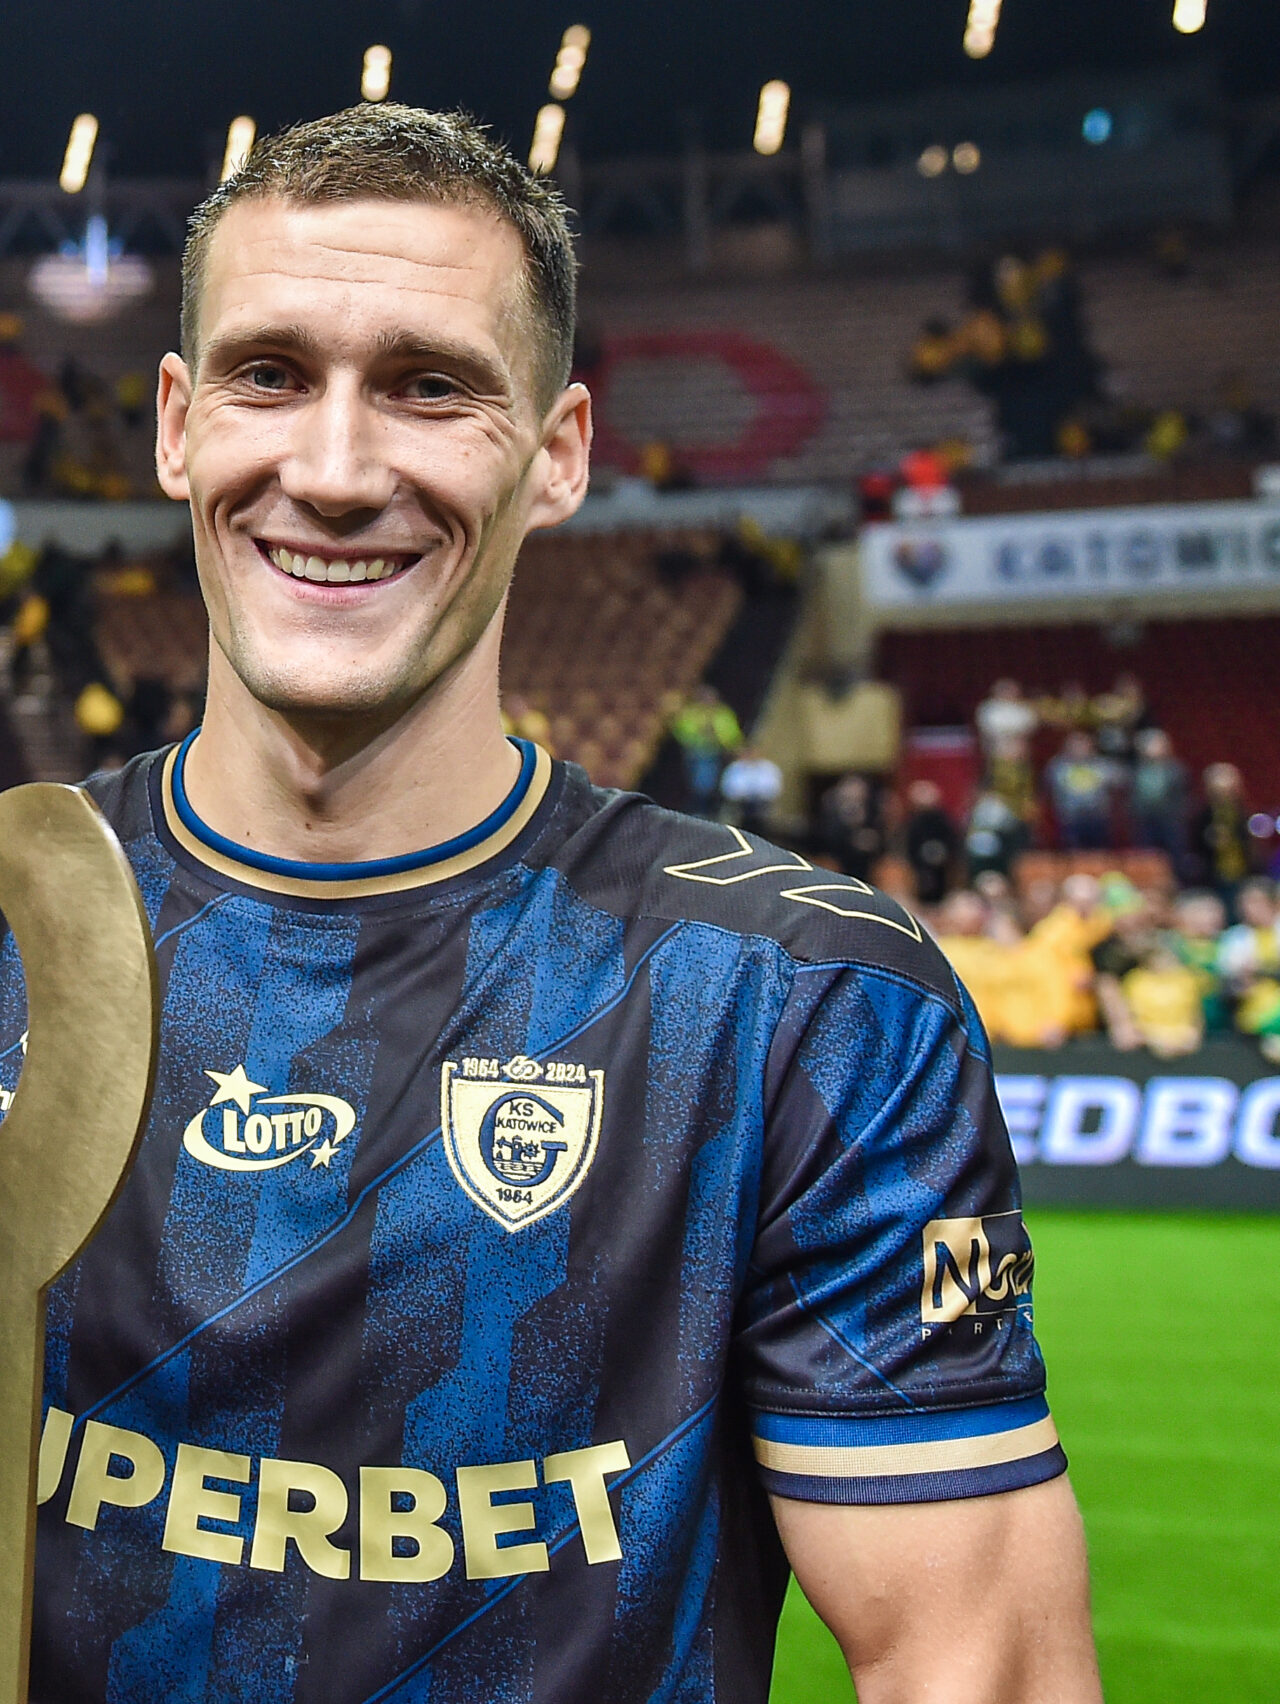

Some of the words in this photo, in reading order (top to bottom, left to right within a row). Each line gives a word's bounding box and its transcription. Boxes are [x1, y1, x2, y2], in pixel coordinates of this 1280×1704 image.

[462, 1057, 499, 1079] 1964
[545, 1062, 587, 1083] 2024
[509, 1100, 534, 1117] KS
[223, 1107, 322, 1154] LOTTO
[495, 1117, 558, 1134] KATOWICE
[495, 1187, 534, 1205] 1964
